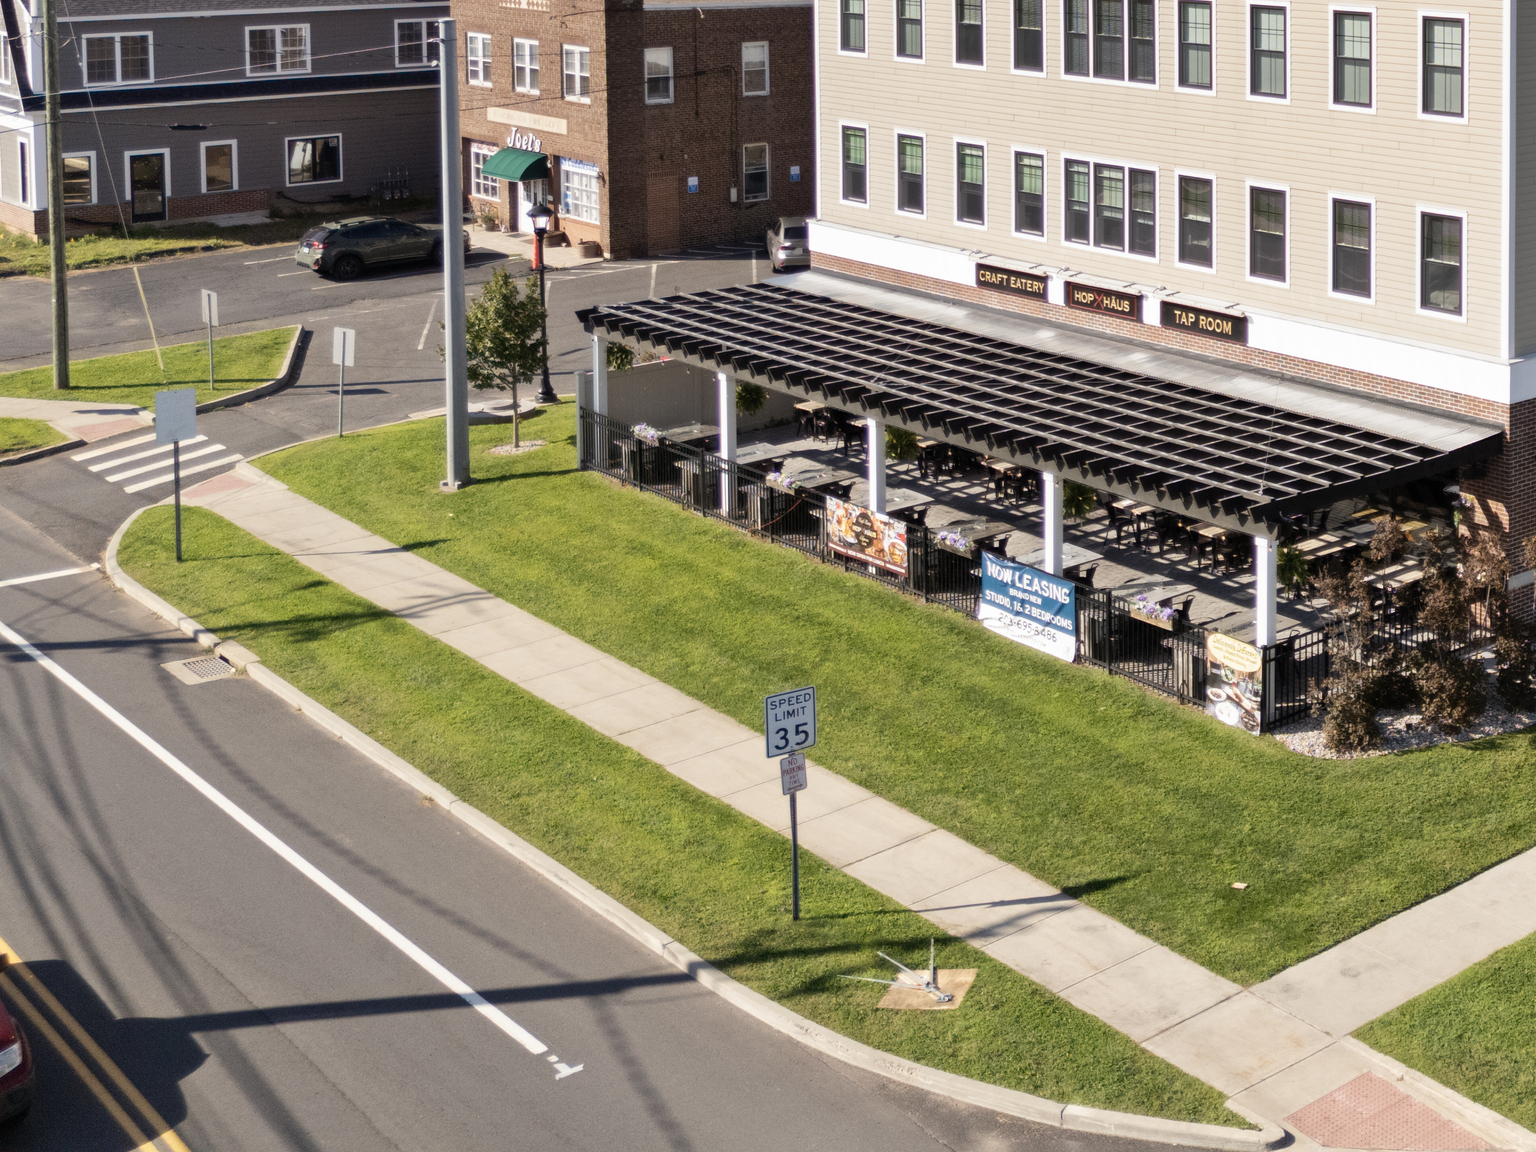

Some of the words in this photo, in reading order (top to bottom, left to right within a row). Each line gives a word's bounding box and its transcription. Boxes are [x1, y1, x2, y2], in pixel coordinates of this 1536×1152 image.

[507, 127, 542, 152] Joel's
[979, 270, 1008, 286] CRAFT
[1010, 276, 1045, 294] EATERY
[1074, 290, 1095, 305] HOP
[1174, 310, 1196, 327] TAP
[1199, 315, 1232, 335] ROOM
[986, 561, 1013, 585] NOW
[1015, 572, 1070, 604] LEASING
[1009, 588, 1030, 601] BRAND
[1030, 595, 1043, 606] NEW
[985, 590, 1013, 610] STUDIO,
[1024, 605, 1031, 615] 2
[1031, 608, 1073, 631] BEDROOMS
[770, 692, 812, 711] SPEED
[775, 706, 806, 721] LIMIT
[774, 722, 810, 751] 35
[783, 764, 805, 777] PARKING
[787, 757, 798, 767] NO
[789, 773, 799, 781] ANY
[789, 779, 801, 787] TIME
